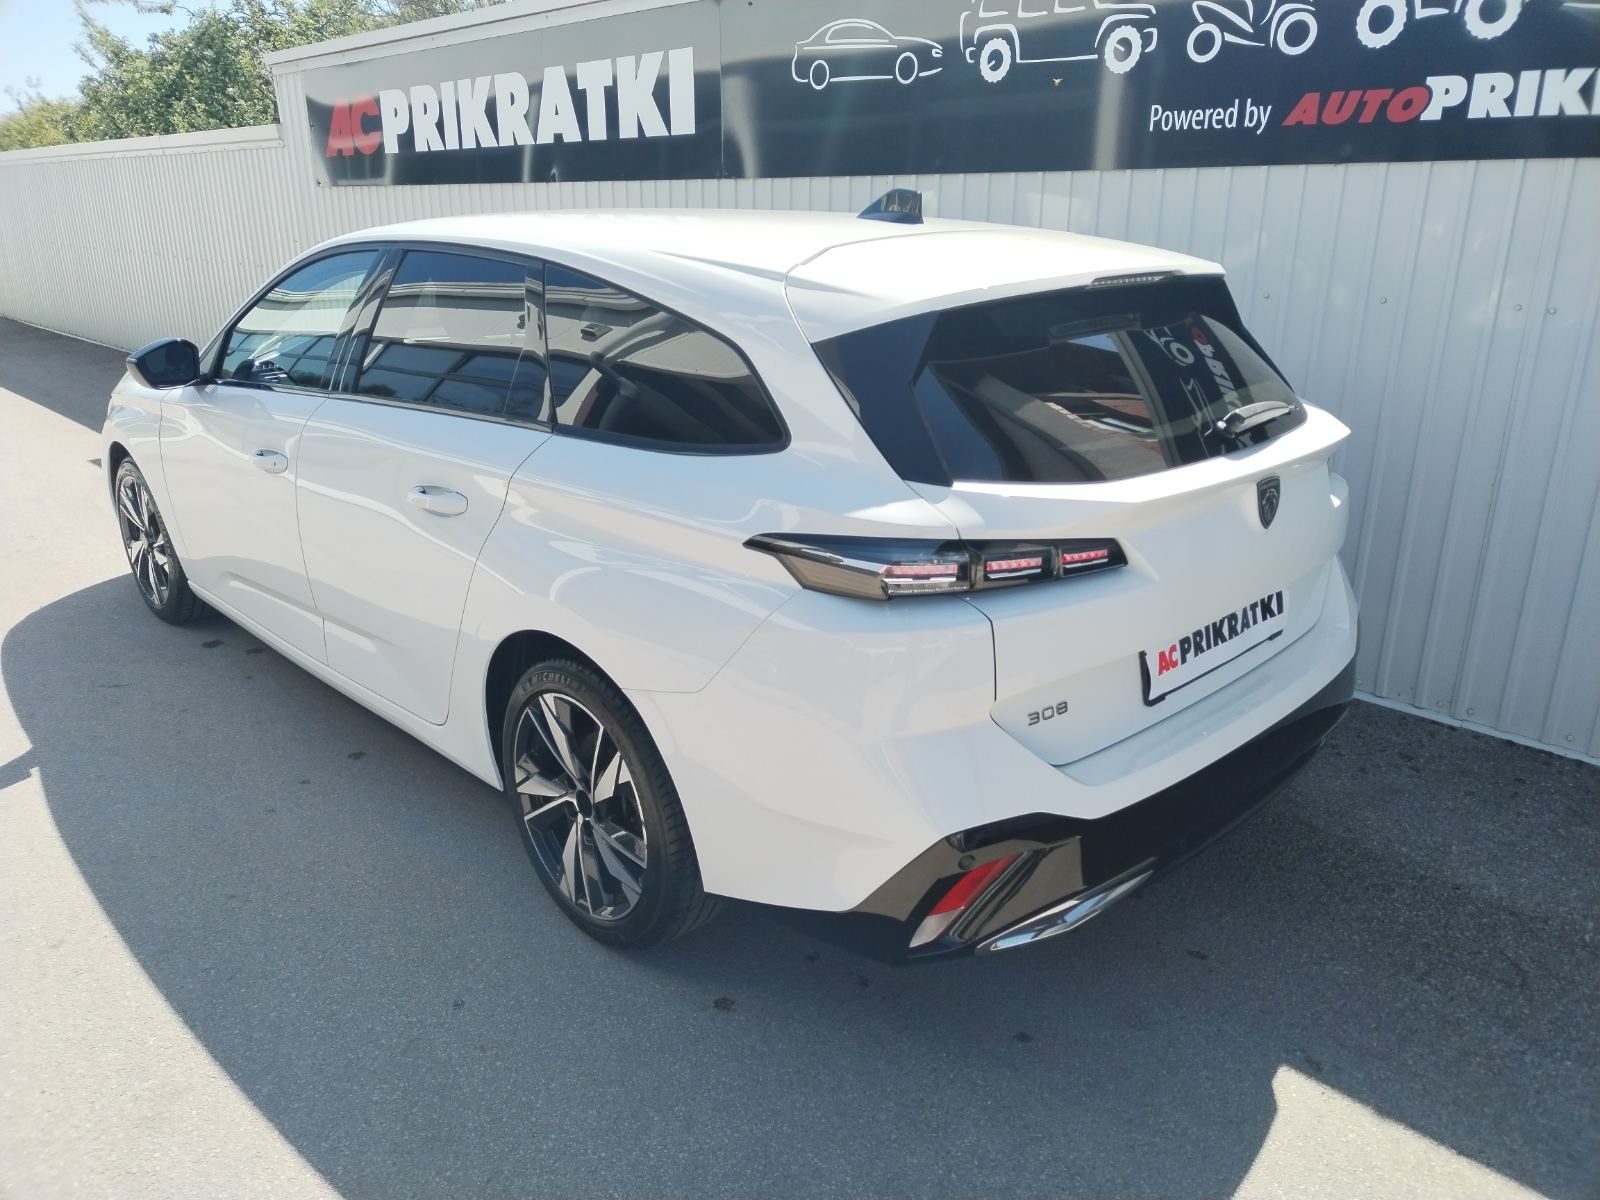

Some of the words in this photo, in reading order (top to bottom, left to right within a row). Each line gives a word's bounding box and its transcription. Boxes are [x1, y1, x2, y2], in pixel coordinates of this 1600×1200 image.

[1149, 98, 1238, 132] Powered
[1244, 98, 1272, 135] by
[1281, 67, 1600, 126] AUTOPRIK
[1027, 701, 1069, 726] 308
